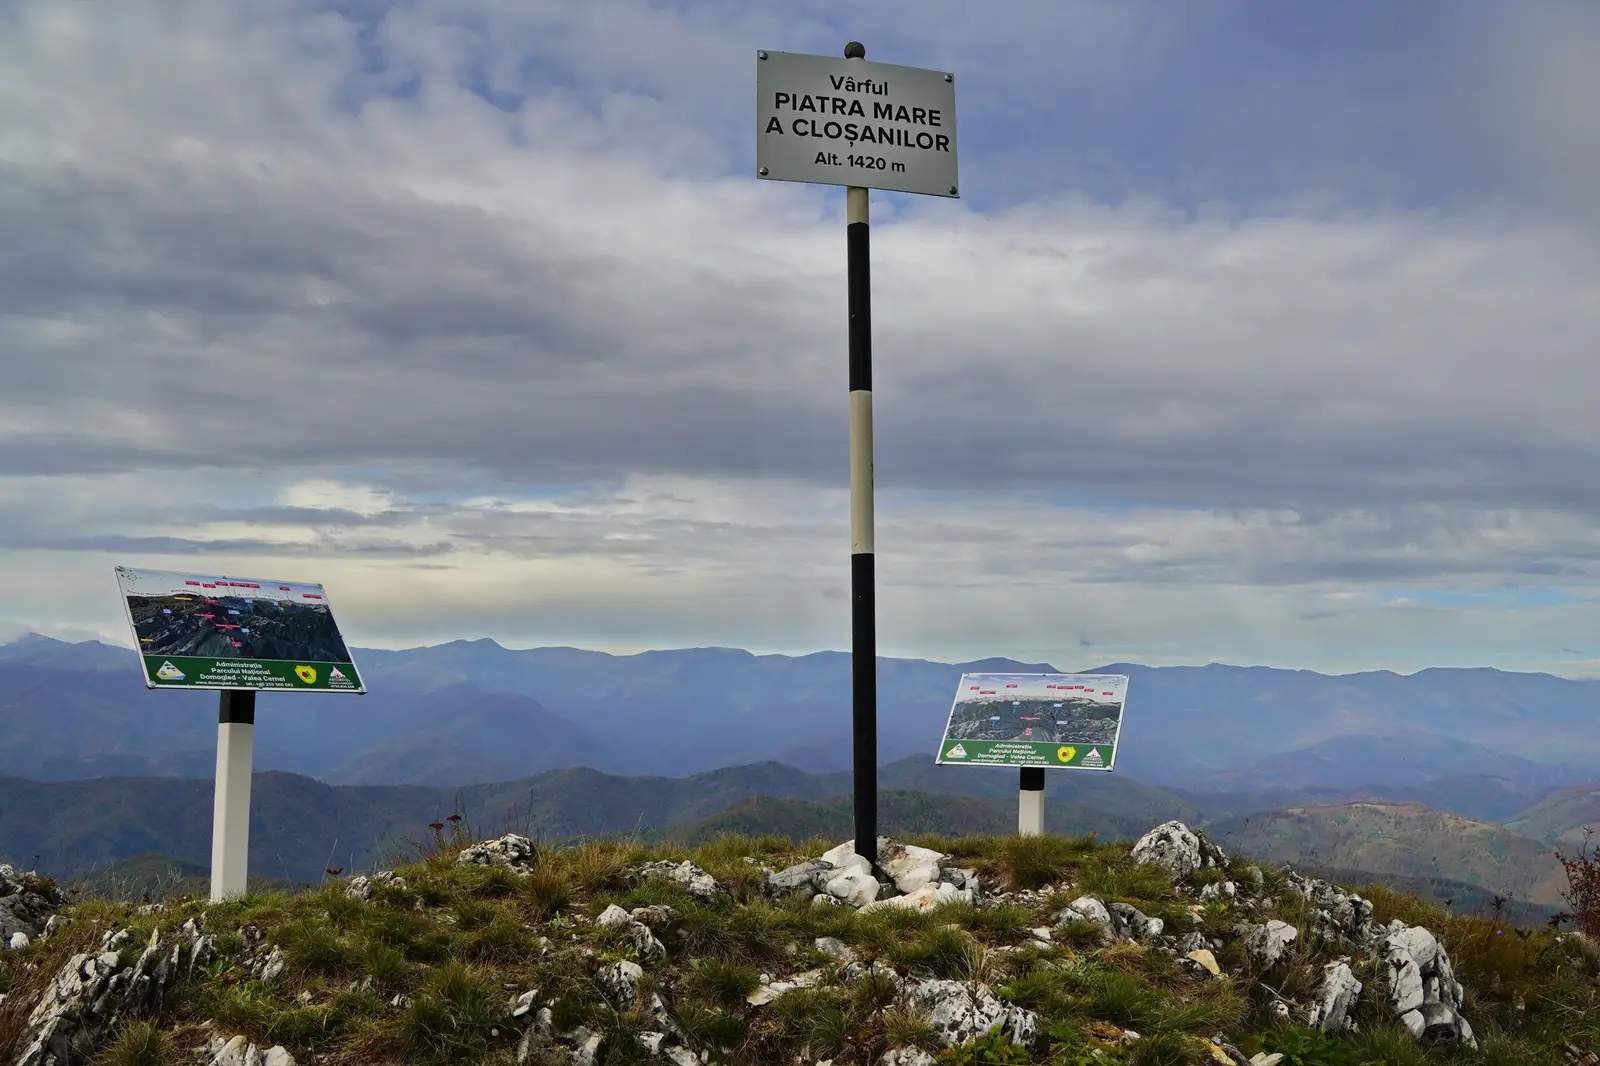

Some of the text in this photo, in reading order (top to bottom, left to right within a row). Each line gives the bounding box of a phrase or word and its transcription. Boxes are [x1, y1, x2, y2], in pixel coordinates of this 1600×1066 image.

[829, 74, 889, 96] Vârful
[775, 91, 942, 127] PIATRA MARE
[765, 116, 950, 153] A CLOȘANILOR
[814, 151, 906, 173] Alt. 1420 m
[199, 673, 237, 681] Domogled
